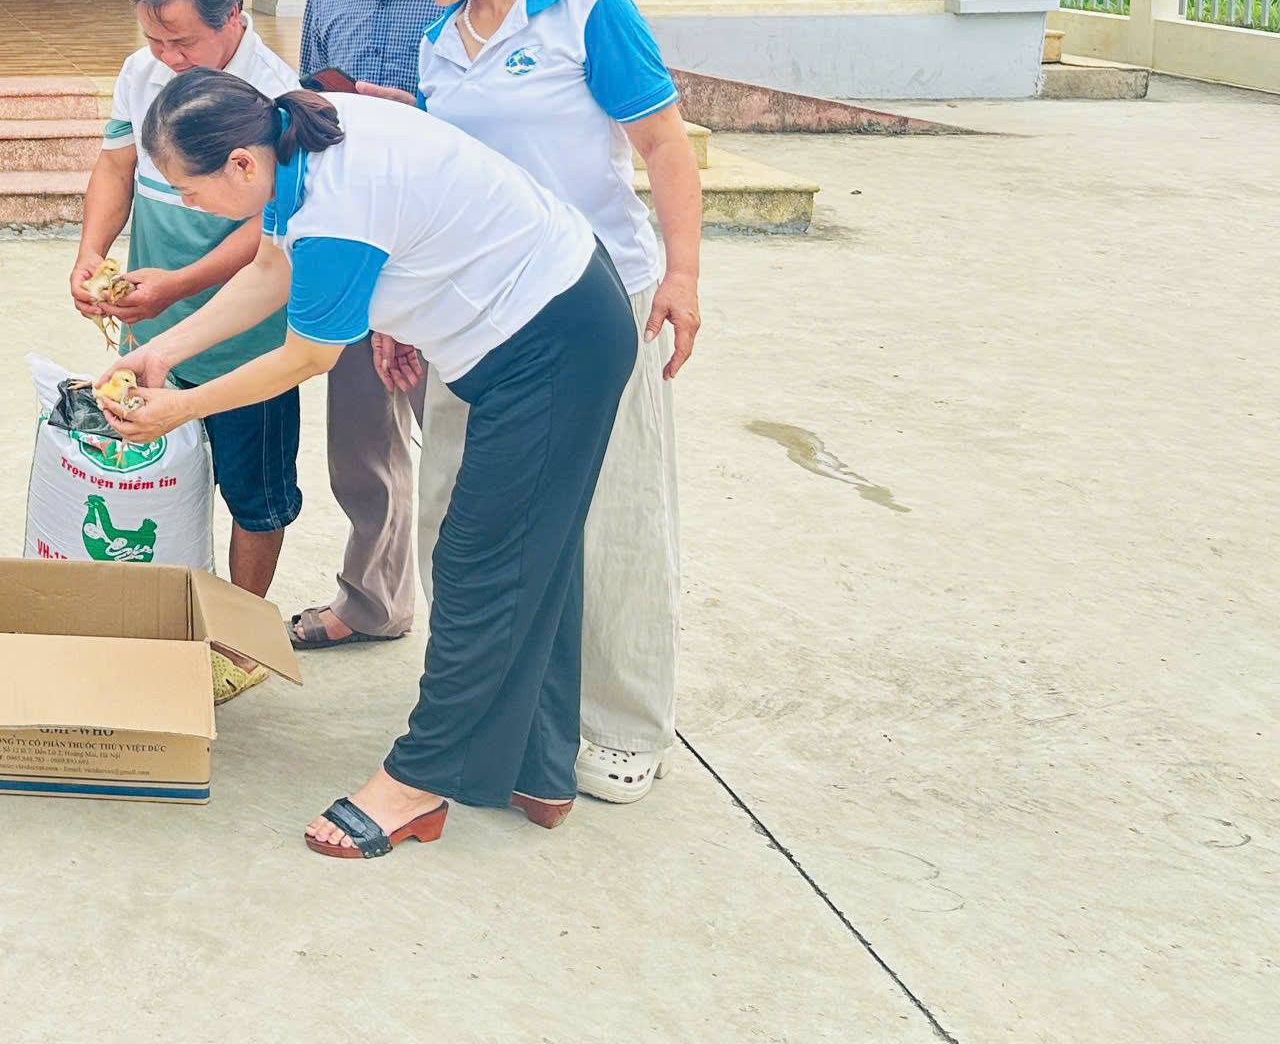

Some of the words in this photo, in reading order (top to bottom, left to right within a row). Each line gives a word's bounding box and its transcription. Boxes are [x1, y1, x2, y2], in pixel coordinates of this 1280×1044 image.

[61, 456, 86, 480] Trọn
[90, 475, 114, 490] vẹn
[118, 476, 154, 490] niềm
[37, 538, 67, 559] VH-
